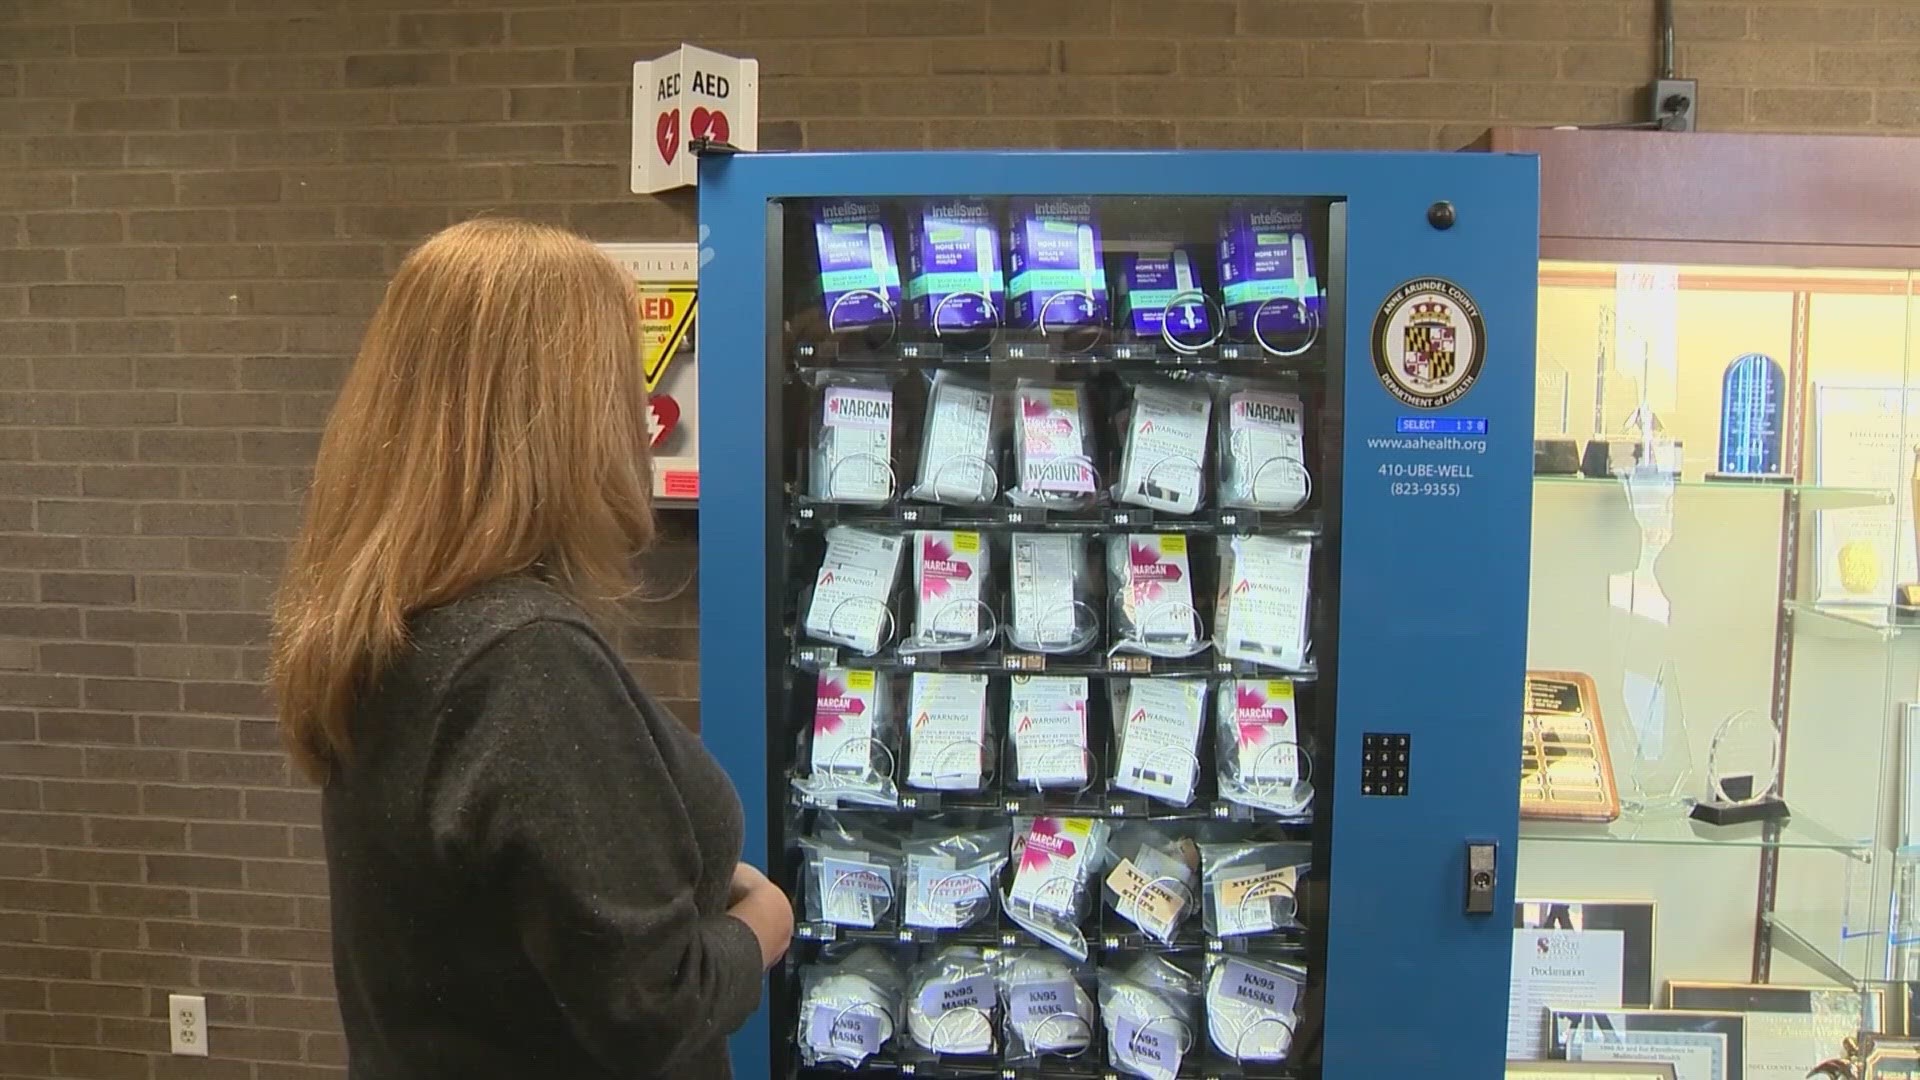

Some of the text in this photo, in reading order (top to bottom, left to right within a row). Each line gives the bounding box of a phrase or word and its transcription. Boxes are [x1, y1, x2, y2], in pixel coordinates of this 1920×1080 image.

[658, 72, 681, 101] AED
[692, 70, 730, 99] AED
[822, 201, 882, 218] InteliSwab
[932, 202, 990, 218] InteliSwab
[1034, 201, 1092, 216] InteliSwab
[1250, 210, 1303, 226] InteliSwab
[935, 242, 971, 251] HOME TEST
[1037, 240, 1073, 249] HOME TEST
[1254, 249, 1288, 259] HOME TEST
[620, 260, 690, 271] RILLA
[1155, 263, 1170, 271] TEST
[1383, 281, 1478, 319] ANNE ARUNDEL COUNTY
[639, 298, 674, 321] ED
[642, 324, 672, 334] ipment
[903, 346, 918, 357] 112
[1009, 347, 1024, 358] 114
[1380, 372, 1476, 408] DEPARTMENT of HEALTH
[838, 397, 891, 421] NARCAN
[1245, 402, 1296, 426] NARCAN
[1403, 419, 1436, 430] SELECT
[1154, 425, 1193, 440] WARNING!
[1367, 437, 1487, 454] www.aahealth.org
[1028, 463, 1082, 482] NARCAN
[1378, 463, 1474, 478] 410-UBE-WELL
[1390, 482, 1461, 498] (823-9355)
[799, 508, 814, 519] 120
[903, 510, 918, 521] 122
[1007, 513, 1023, 523] 124
[923, 559, 958, 573] NARCAN
[1133, 564, 1168, 576] NARCAN
[1250, 582, 1291, 595] WARNING!
[902, 656, 917, 666] 132
[816, 697, 851, 711] NARCAN
[930, 713, 969, 723] WARNING!
[1146, 711, 1186, 728] WARNING!
[1239, 707, 1274, 720] NARCAN
[1031, 716, 1071, 726] WARNING!
[902, 798, 917, 809] 142
[1005, 802, 1020, 812] 144
[1030, 831, 1064, 851] NARCAN
[835, 869, 884, 884] FENTANY
[928, 878, 983, 889] FENTANY
[1232, 871, 1285, 888] XYLAZINE
[1125, 868, 1173, 903] XYLZINE
[1530, 965, 1586, 977] Proclamation
[1244, 972, 1275, 991] KN95
[943, 985, 974, 1001] KN95
[1029, 991, 1058, 1002] KN95
[1237, 985, 1276, 1005] MASKS
[941, 997, 979, 1012] MASKS
[1028, 1004, 1063, 1016] MASKS
